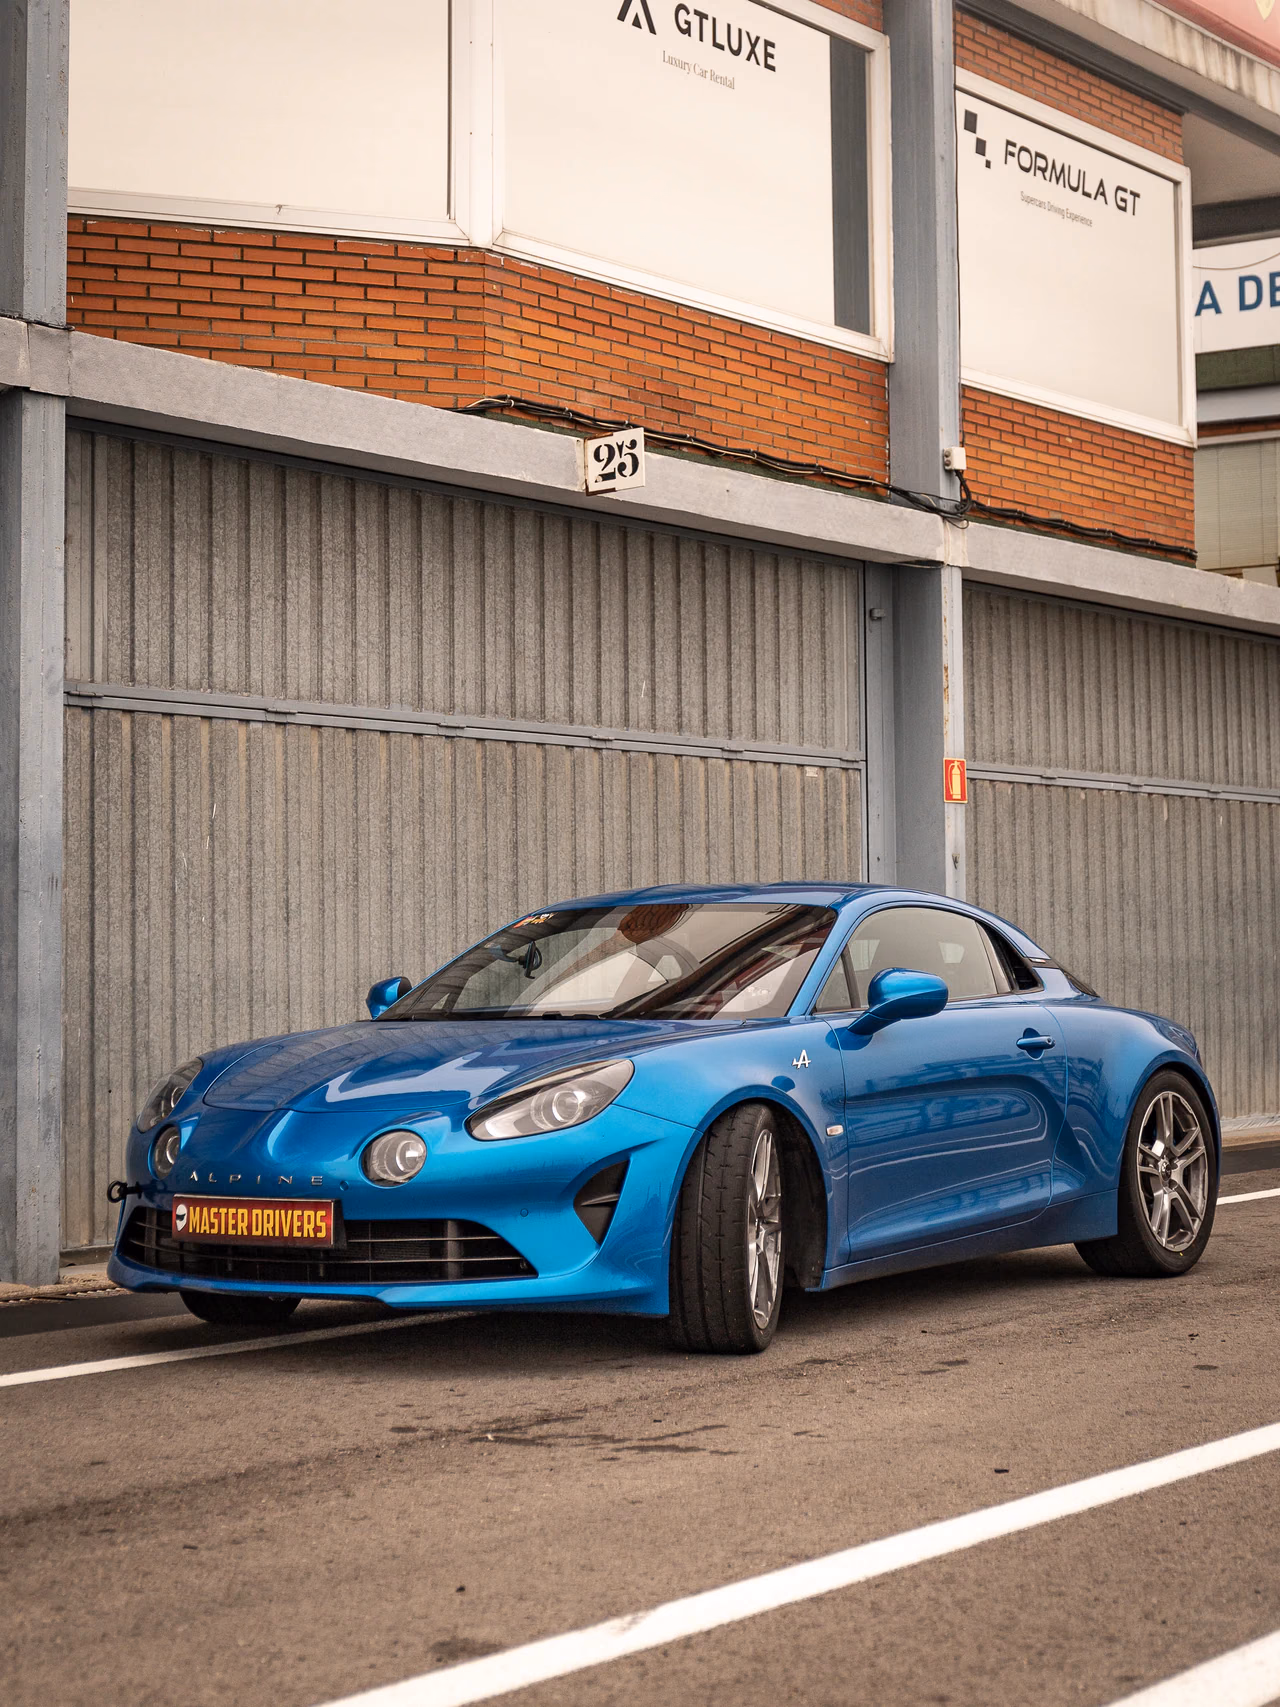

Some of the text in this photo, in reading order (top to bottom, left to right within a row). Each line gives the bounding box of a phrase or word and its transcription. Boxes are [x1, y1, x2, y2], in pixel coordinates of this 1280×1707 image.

[674, 3, 776, 72] GTLUXE
[662, 50, 735, 90] Luxury Car Rental
[1004, 138, 1141, 216] FORMULA GT
[1020, 191, 1093, 227] Supercars Driving Experience
[593, 438, 640, 483] 25
[189, 1170, 323, 1186] ALPINE
[188, 1206, 327, 1238] MASTER DRIVERS
